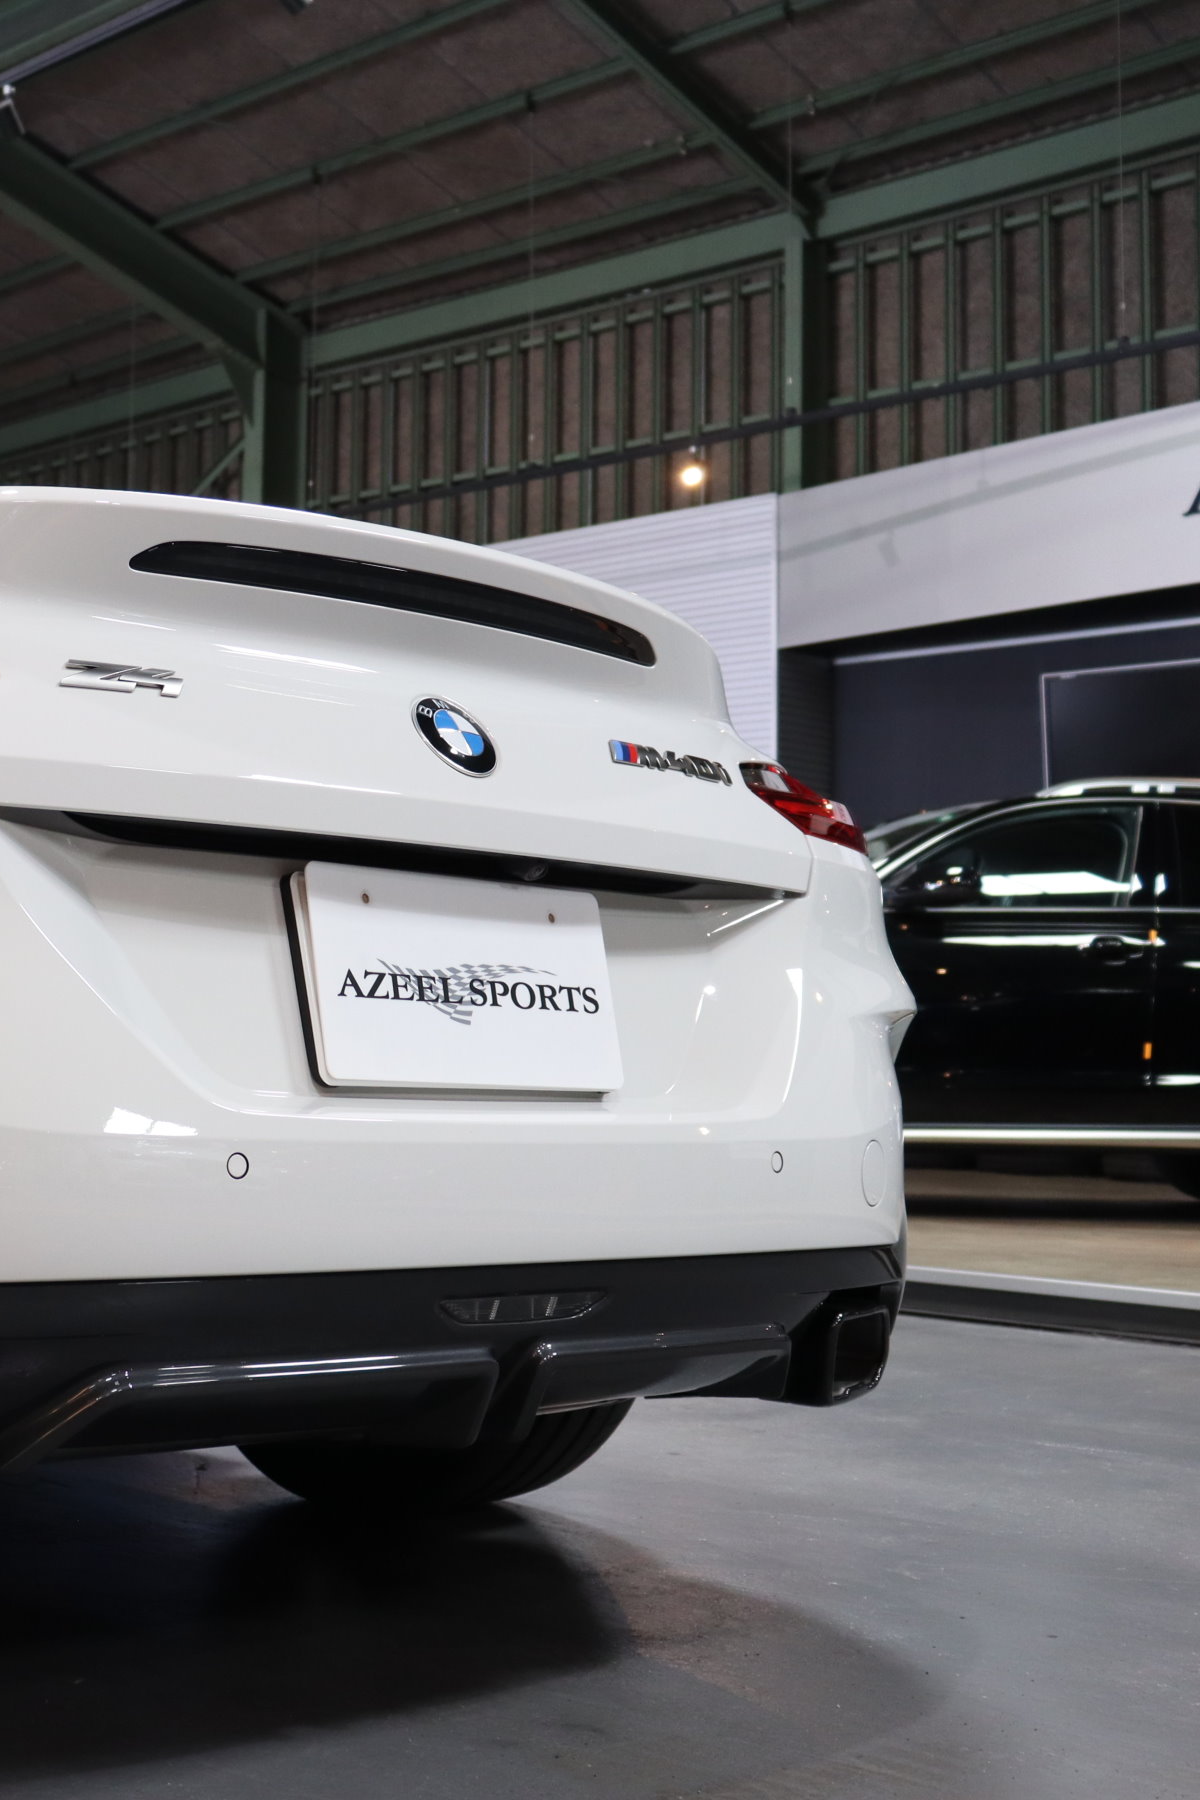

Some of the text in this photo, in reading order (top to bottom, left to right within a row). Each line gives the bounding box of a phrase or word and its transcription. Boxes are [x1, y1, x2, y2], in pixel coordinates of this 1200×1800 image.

[58, 659, 184, 698] Z4
[337, 968, 601, 1015] AZEEL SPORTS
